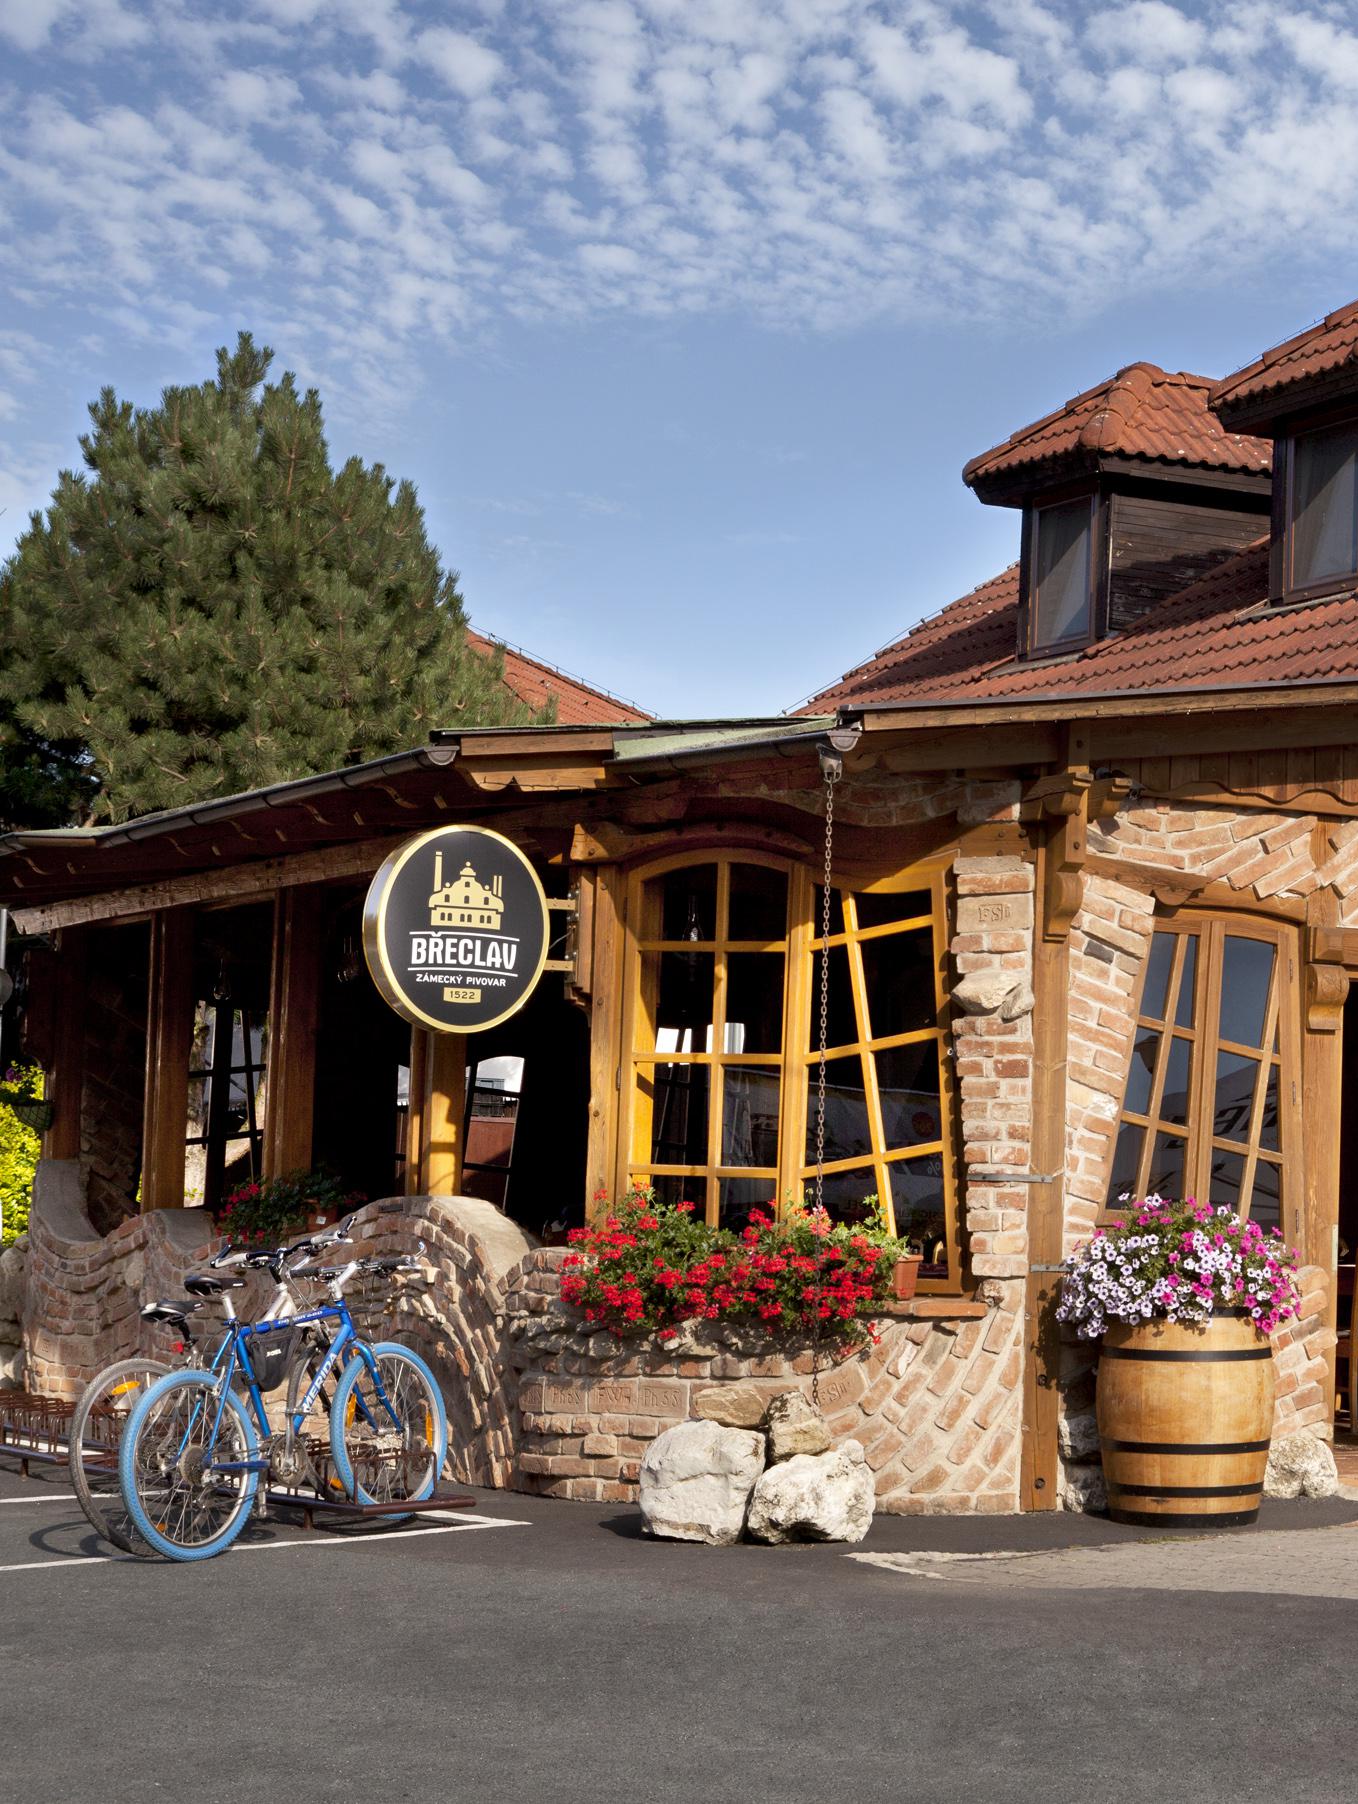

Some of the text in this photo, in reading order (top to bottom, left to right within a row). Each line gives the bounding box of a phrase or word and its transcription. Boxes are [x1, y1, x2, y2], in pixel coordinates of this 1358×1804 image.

[411, 932, 517, 970] BŘECLAV
[415, 972, 507, 987] ZÁMECKÝ PIVOVAR
[449, 990, 475, 1000] 1522
[302, 1352, 338, 1413] MERIDA
